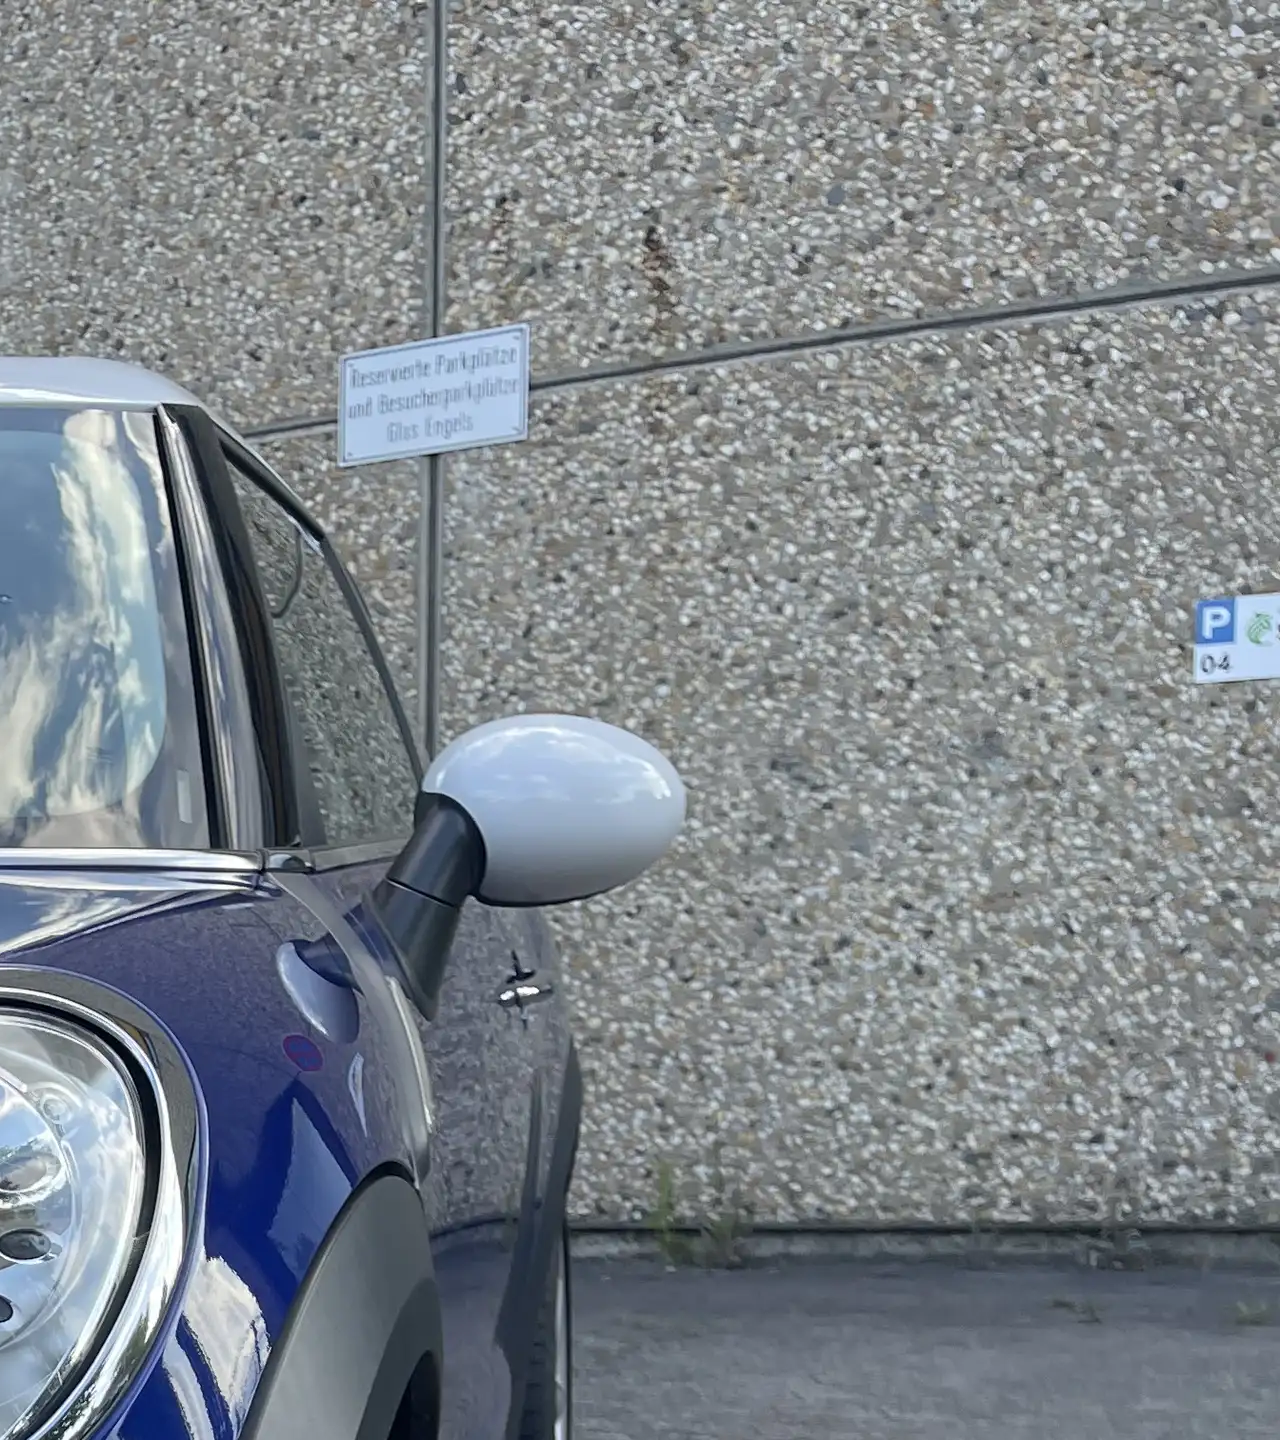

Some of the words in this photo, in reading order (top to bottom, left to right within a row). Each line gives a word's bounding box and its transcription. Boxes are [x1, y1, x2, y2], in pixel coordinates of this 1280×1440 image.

[349, 359, 431, 388] Reservierte
[348, 396, 372, 418] und
[424, 412, 473, 439] Engels
[1202, 606, 1231, 639] P
[1201, 653, 1230, 674] 04
